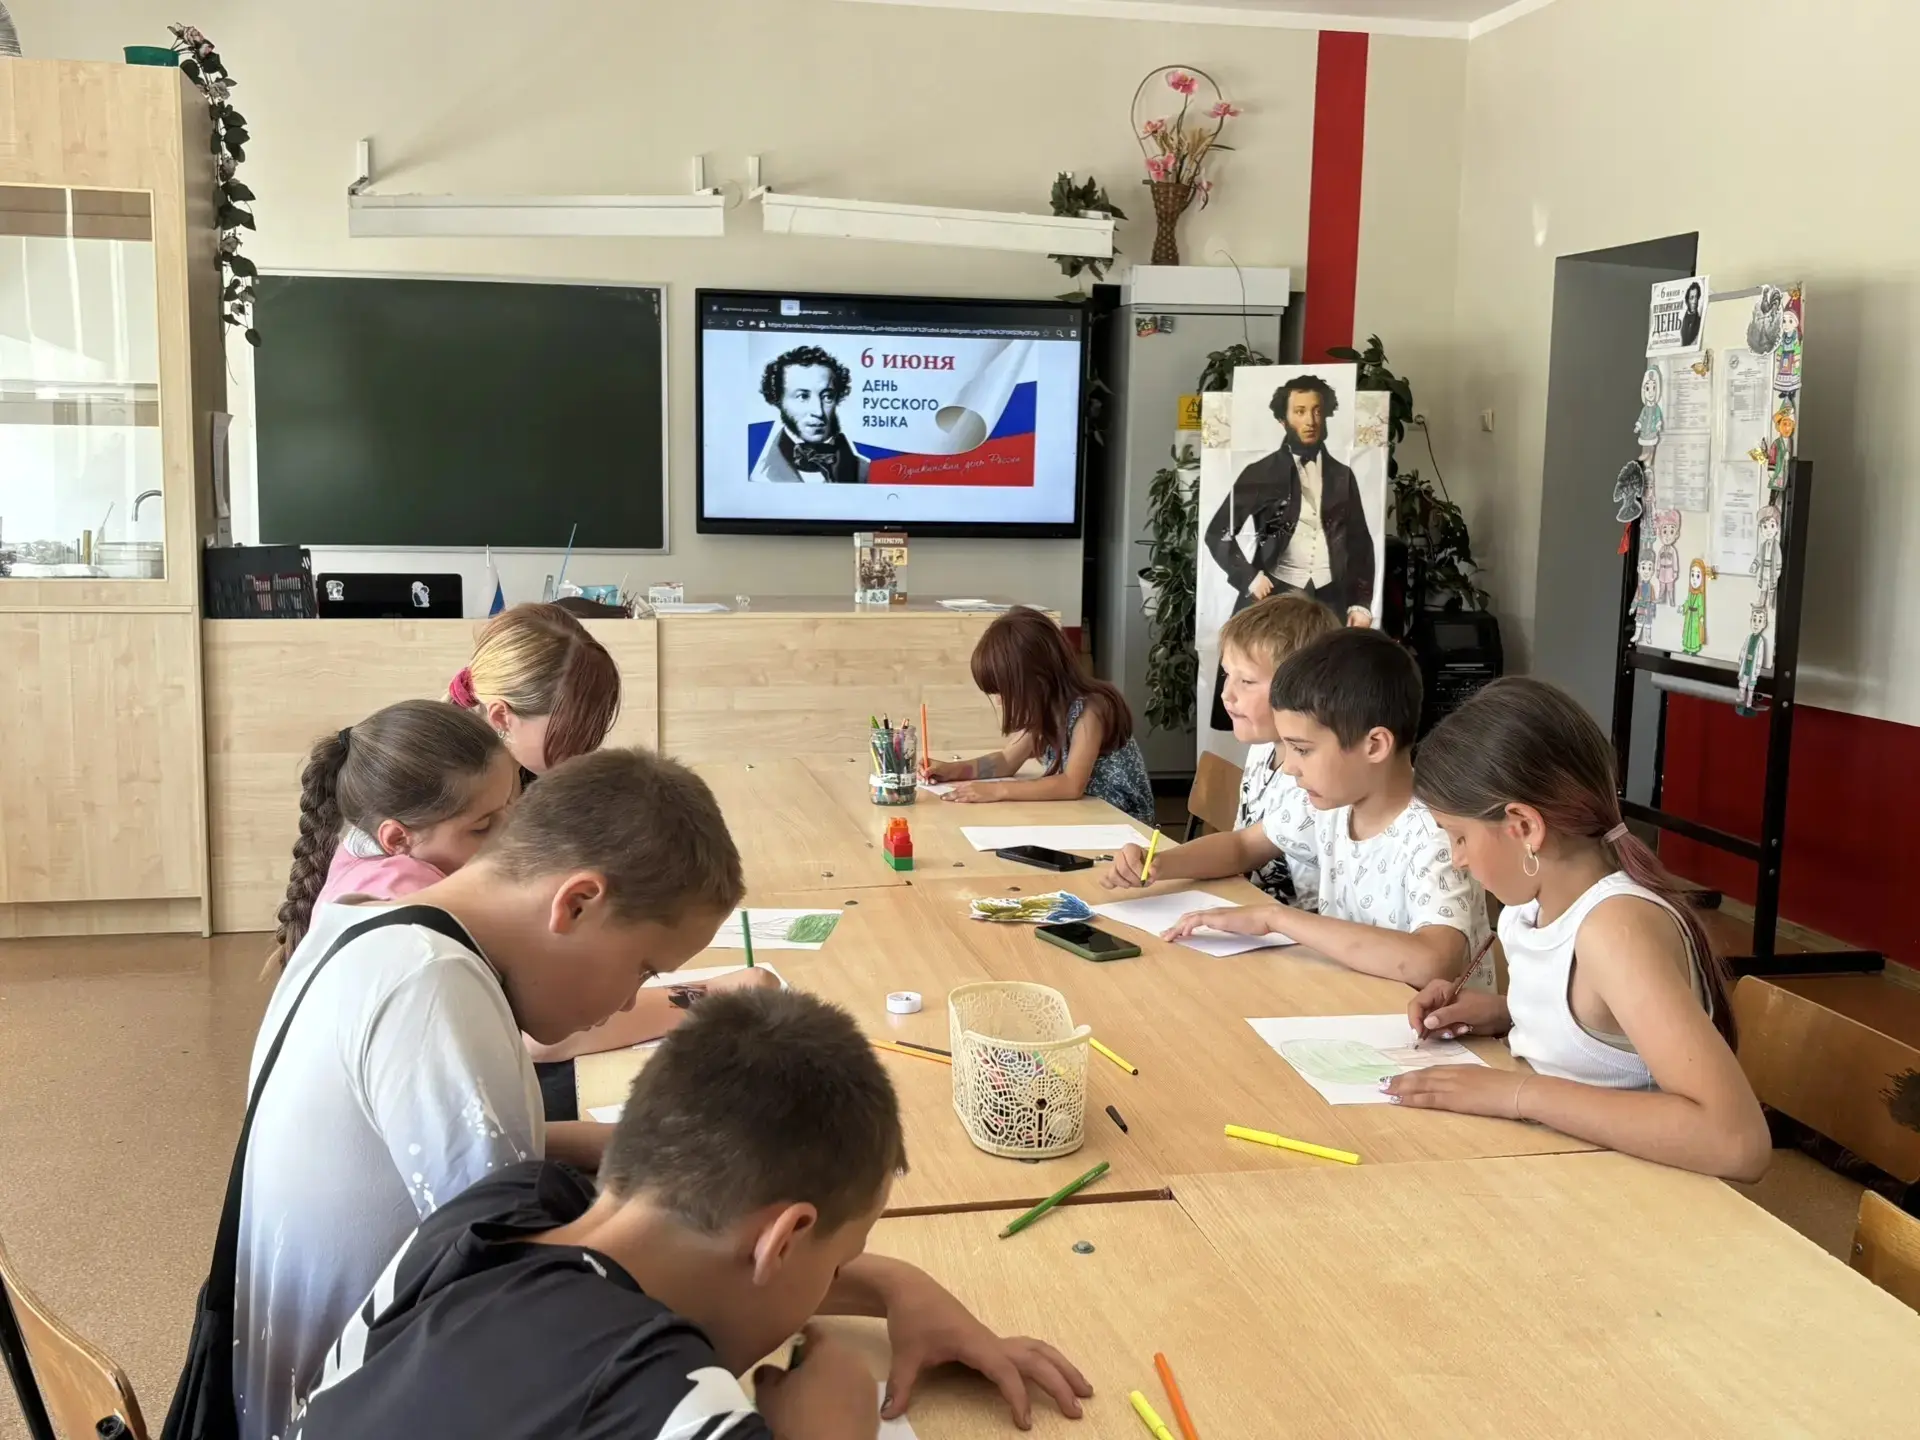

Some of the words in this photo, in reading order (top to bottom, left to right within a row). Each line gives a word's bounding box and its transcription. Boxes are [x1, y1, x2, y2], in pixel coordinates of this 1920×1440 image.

[1661, 287, 1665, 298] 6
[1652, 312, 1682, 337] ДЕНЬ
[861, 347, 874, 368] 6
[882, 354, 955, 371] июня
[862, 379, 898, 393] ДЕНЬ
[862, 397, 939, 411] РУССКОГО
[862, 415, 908, 428] ЯЗЫКА
